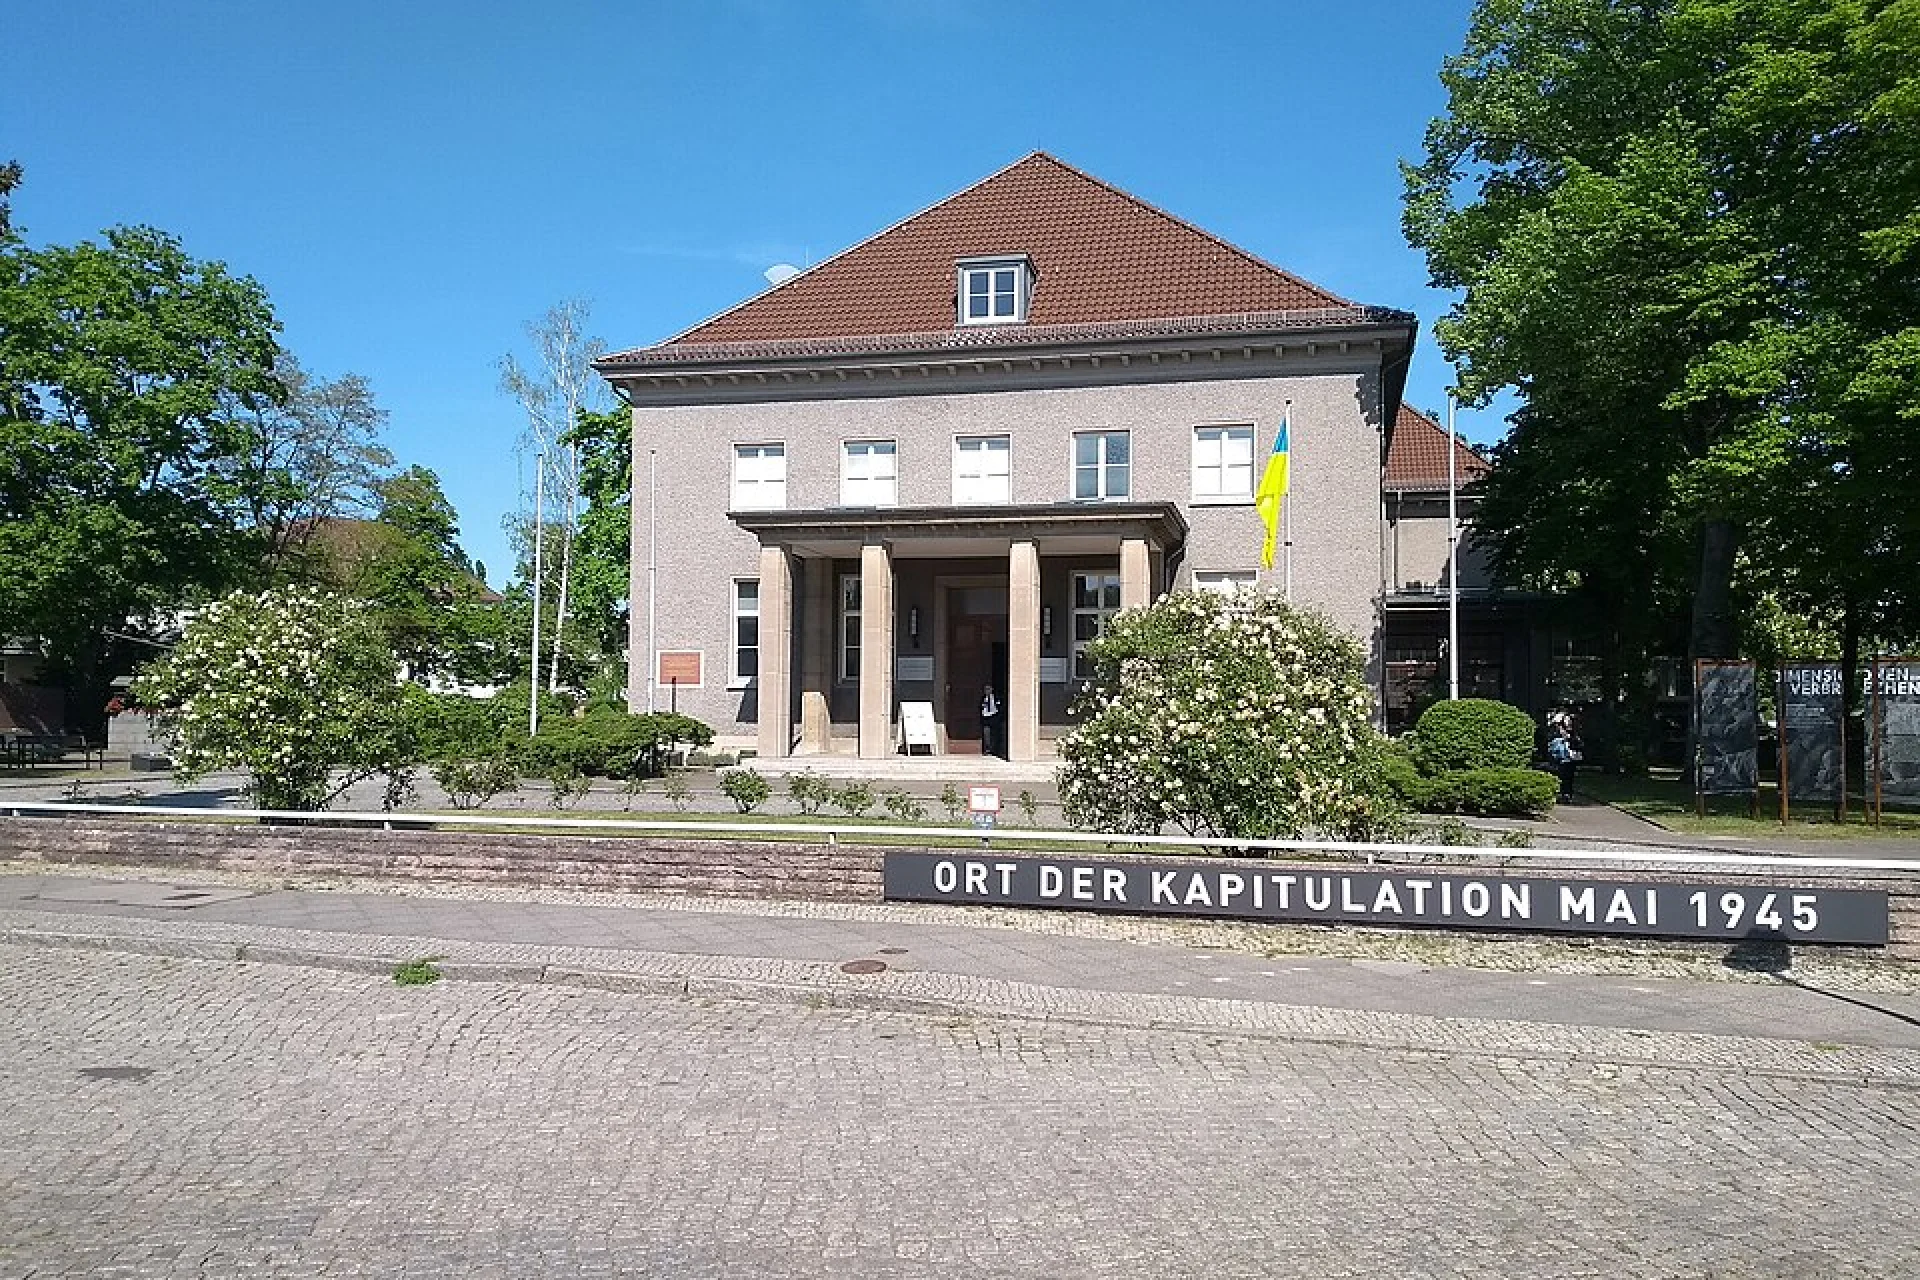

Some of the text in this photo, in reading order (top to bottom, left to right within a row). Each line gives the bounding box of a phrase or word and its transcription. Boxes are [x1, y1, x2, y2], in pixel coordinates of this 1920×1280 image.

[934, 860, 1818, 932] ORT DER KAPITULATION MAI 1945
